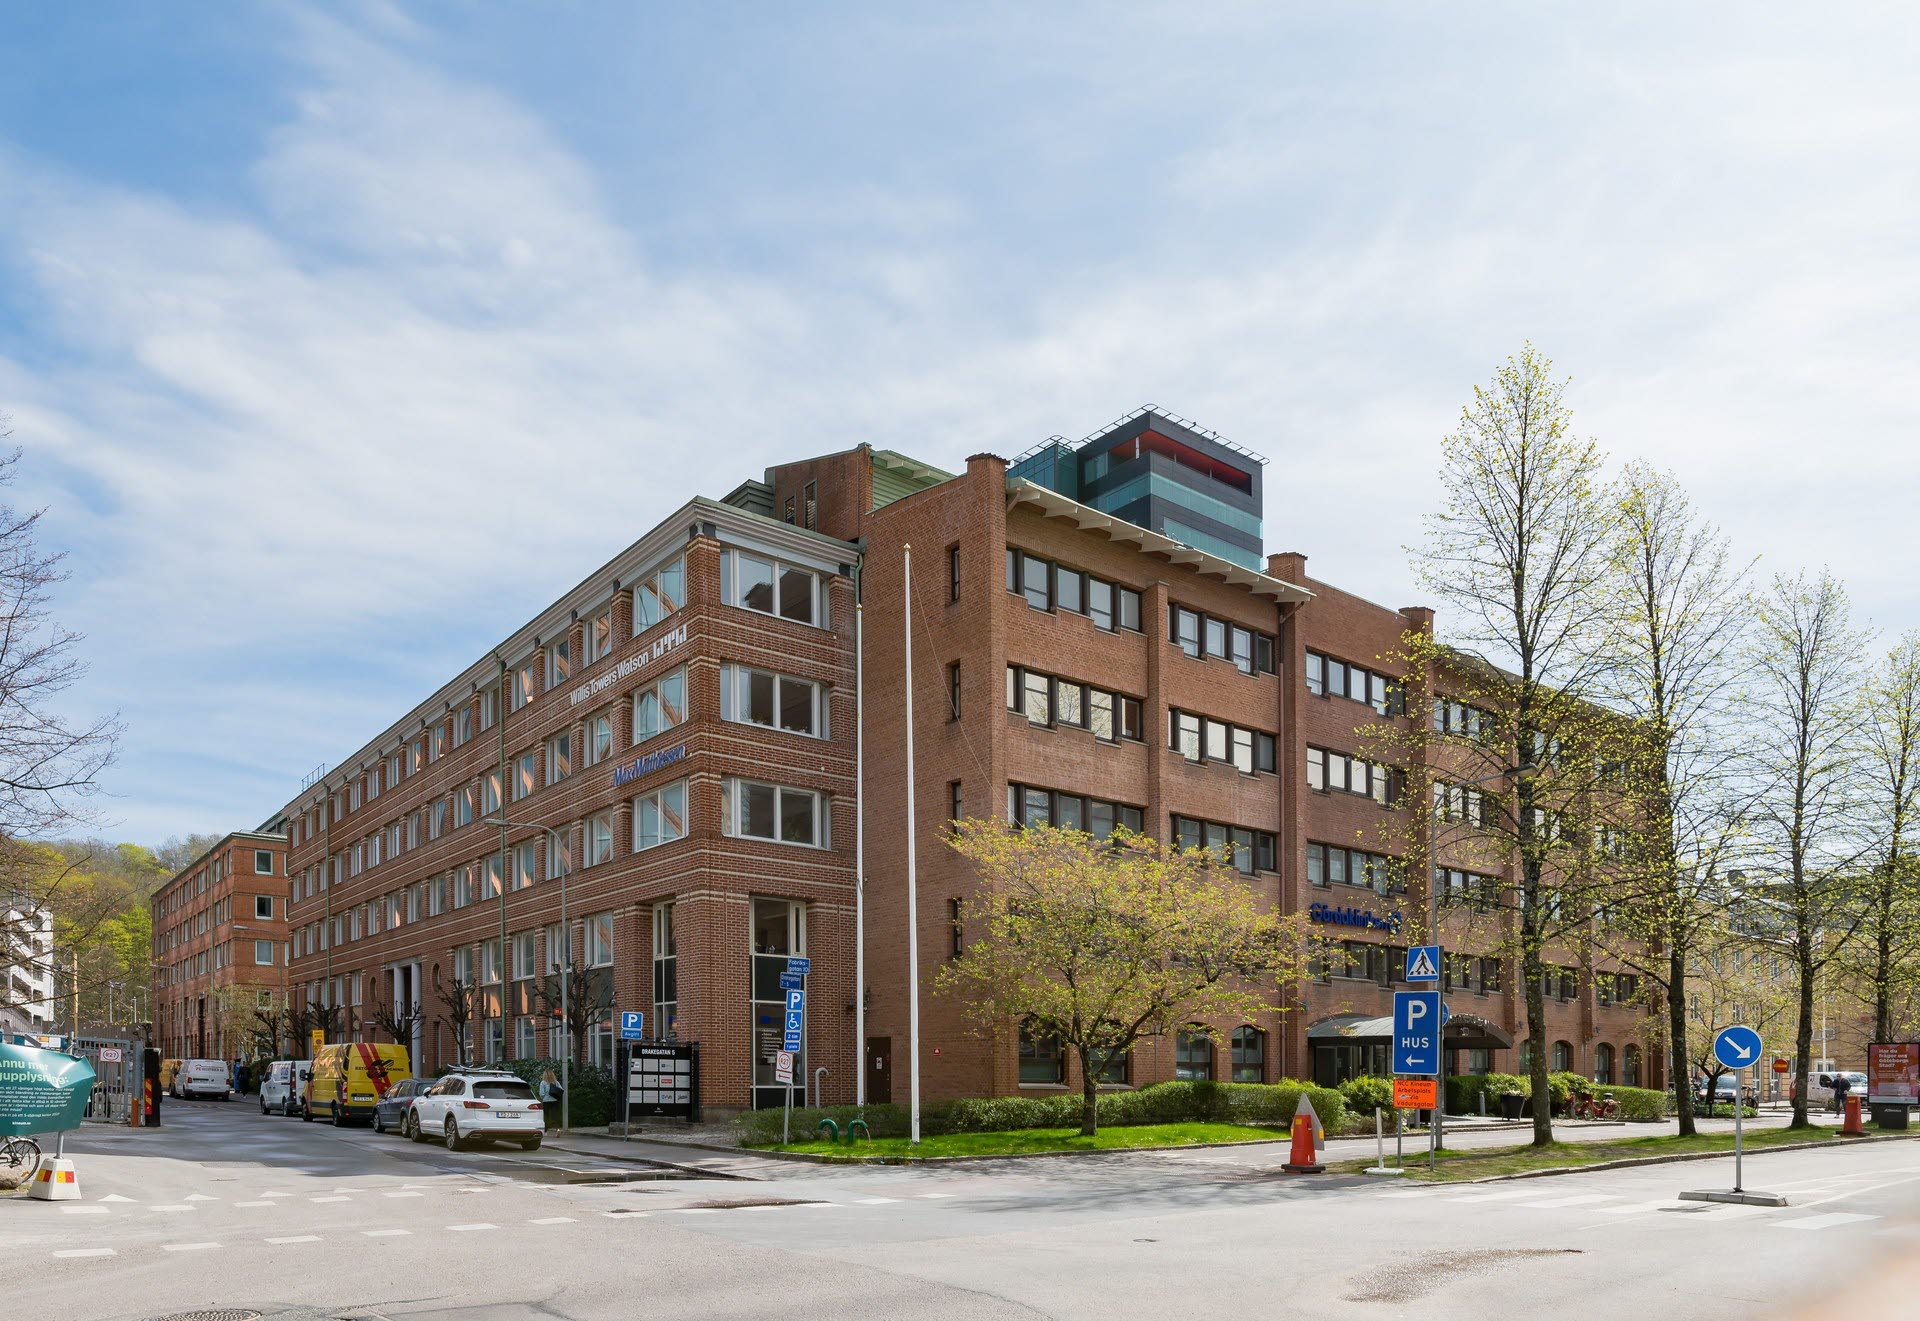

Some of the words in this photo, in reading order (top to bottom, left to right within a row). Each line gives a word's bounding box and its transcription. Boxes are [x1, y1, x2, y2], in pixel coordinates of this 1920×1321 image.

[570, 685, 590, 706] Willis
[590, 670, 617, 695] Towers
[617, 651, 649, 679] Watson
[790, 992, 801, 1009] P
[628, 1014, 638, 1027] P
[1408, 1000, 1427, 1030] P
[1402, 1037, 1429, 1048] HUS
